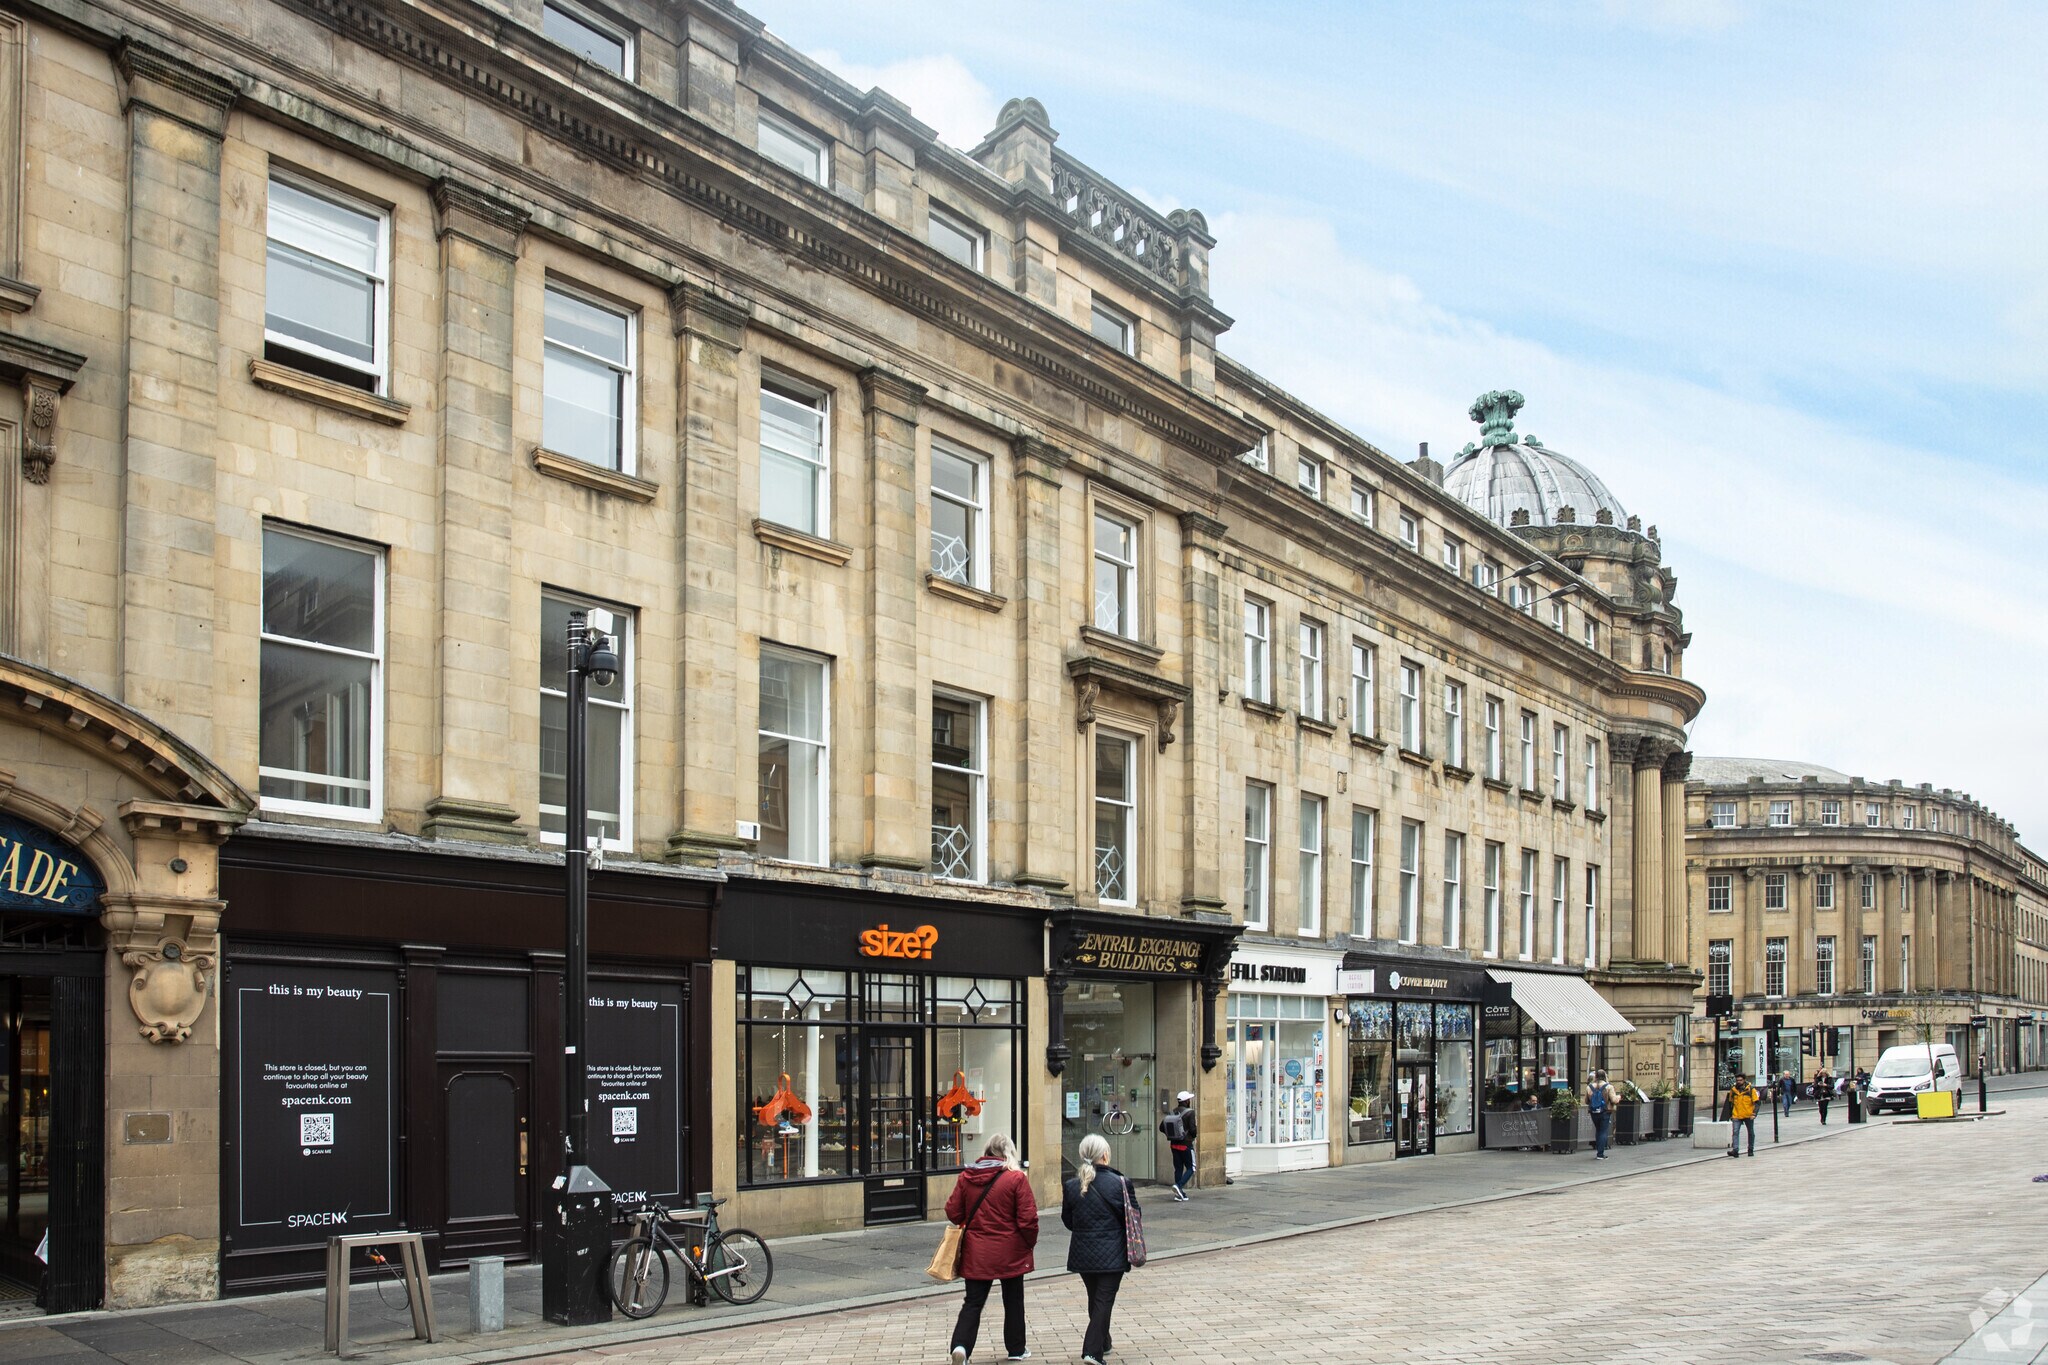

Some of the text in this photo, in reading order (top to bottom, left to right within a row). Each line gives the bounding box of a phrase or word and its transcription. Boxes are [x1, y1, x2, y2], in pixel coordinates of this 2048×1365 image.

[0, 836, 79, 904] ADE
[859, 923, 939, 960] size?
[1078, 933, 1137, 952] ENTRAL
[1098, 951, 1178, 973] BUILDINGS.
[1230, 962, 1306, 984] EFILL STATION
[1400, 976, 1448, 989] COVER BEAUTY
[268, 983, 363, 1000] this is my beauty
[588, 996, 658, 1011] this is my beauty
[1485, 1005, 1510, 1014] CÔTE
[264, 1063, 278, 1071] This
[304, 1063, 328, 1072] closed,
[329, 1063, 340, 1071] but
[614, 1064, 632, 1072] closed,
[1635, 1060, 1660, 1071] CÔTE
[263, 1072, 292, 1080] continue
[302, 1072, 318, 1081] shop
[320, 1072, 328, 1080] all
[346, 1072, 369, 1081] beauty
[285, 1081, 318, 1089] favourites
[319, 1081, 339, 1089] online
[281, 1093, 352, 1108] spacenk.com
[598, 1091, 650, 1103] spacenk.com
[611, 1190, 647, 1204] PACENK
[287, 1211, 348, 1228] SPACENK
